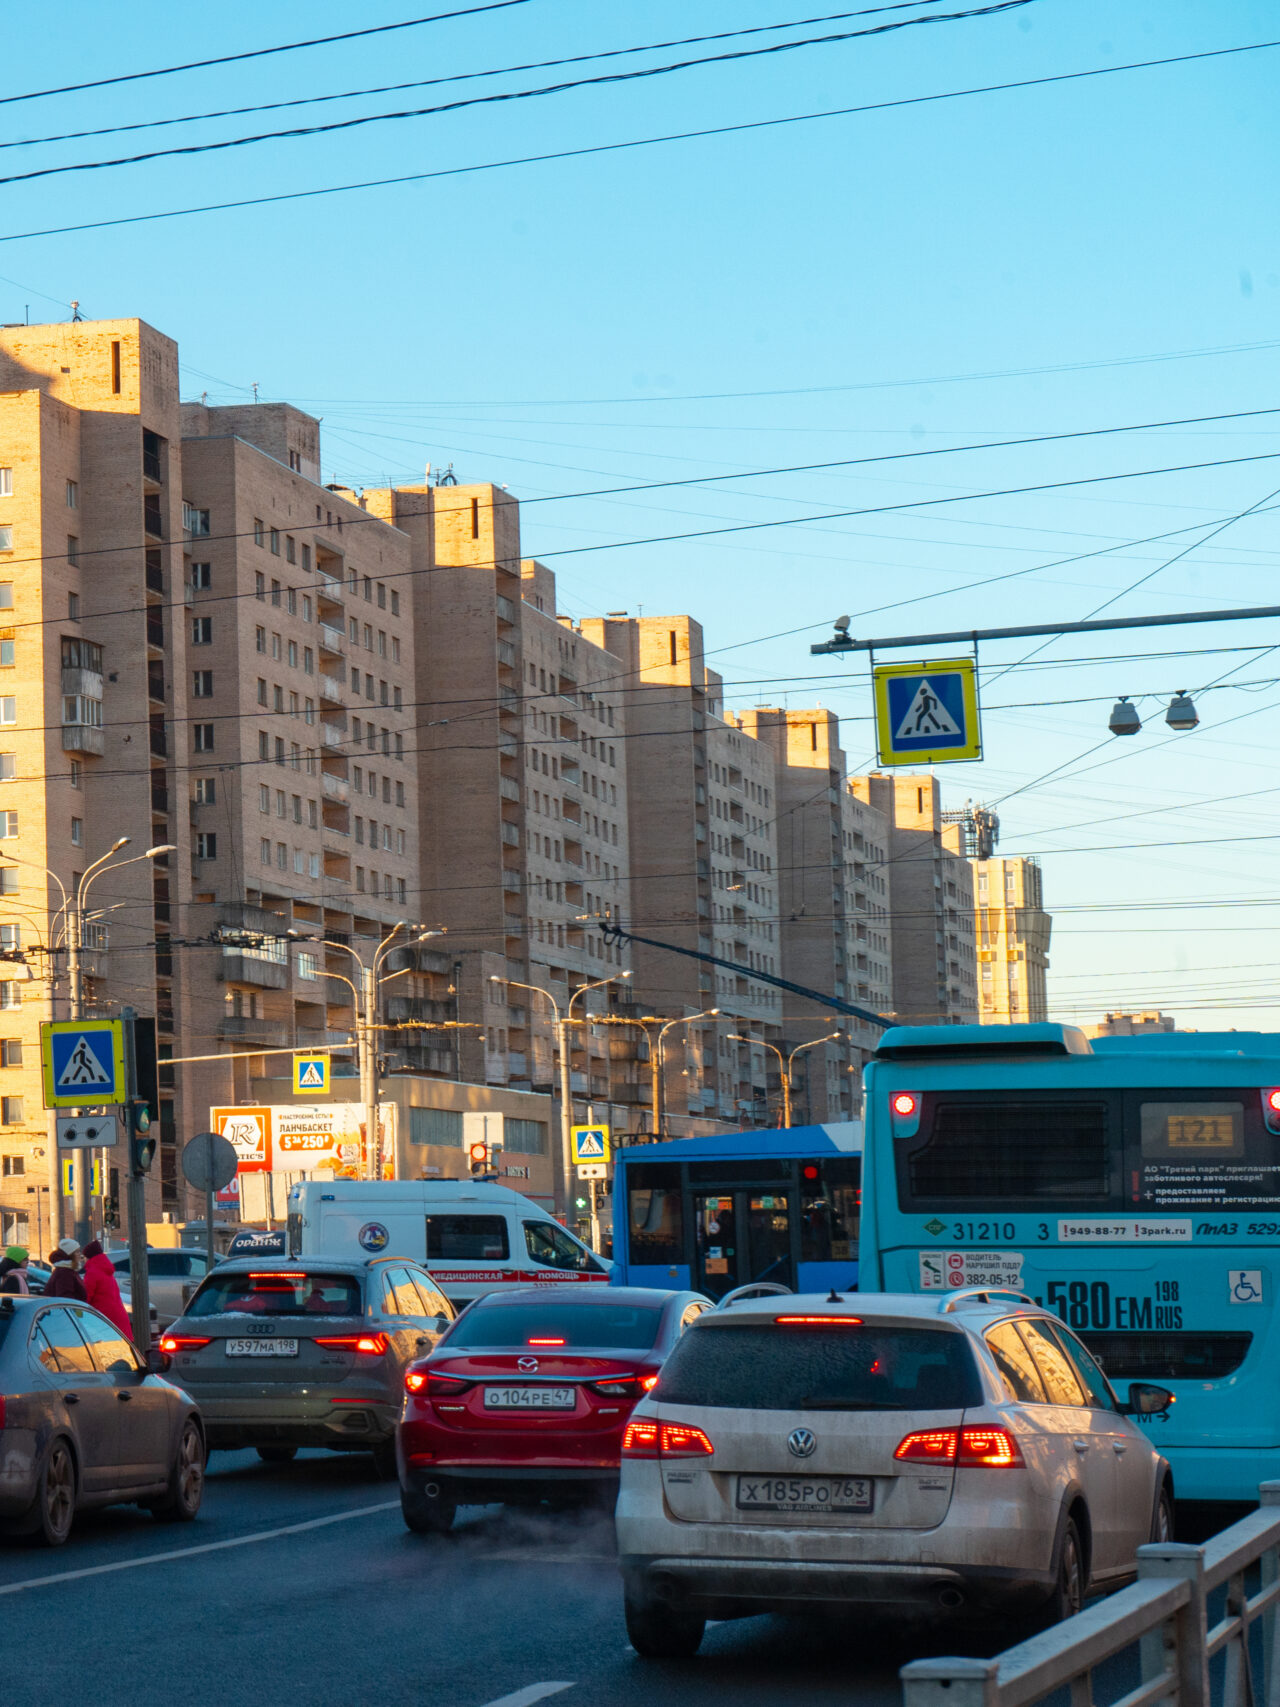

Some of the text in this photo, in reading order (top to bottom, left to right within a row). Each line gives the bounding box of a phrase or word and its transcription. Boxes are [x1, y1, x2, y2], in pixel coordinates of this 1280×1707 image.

[280, 1123, 333, 1133] ЛАНЧБАСКЕТ
[1175, 1120, 1223, 1142] 121
[284, 1136, 292, 1149] 5
[1144, 1165, 1158, 1174] АО
[1144, 1174, 1202, 1182] заботливого
[1155, 1188, 1226, 1196] предоставляем
[1155, 1196, 1213, 1205] проживание
[953, 1222, 1016, 1241] 31210
[1037, 1222, 1050, 1241] 3
[966, 1254, 1002, 1262] ВОДИТЕЛЬ
[966, 1261, 1001, 1270] НАРУШИЛ
[433, 1272, 580, 1281] МЕДИЦИНСКАЯ ПОМОЩЬ
[966, 1273, 1018, 1286] 382-05-12
[1154, 1280, 1180, 1302] 198
[1155, 1305, 1183, 1329] RUS
[278, 1338, 296, 1350] 198
[555, 1389, 570, 1401] 47
[832, 1480, 865, 1498] 763
